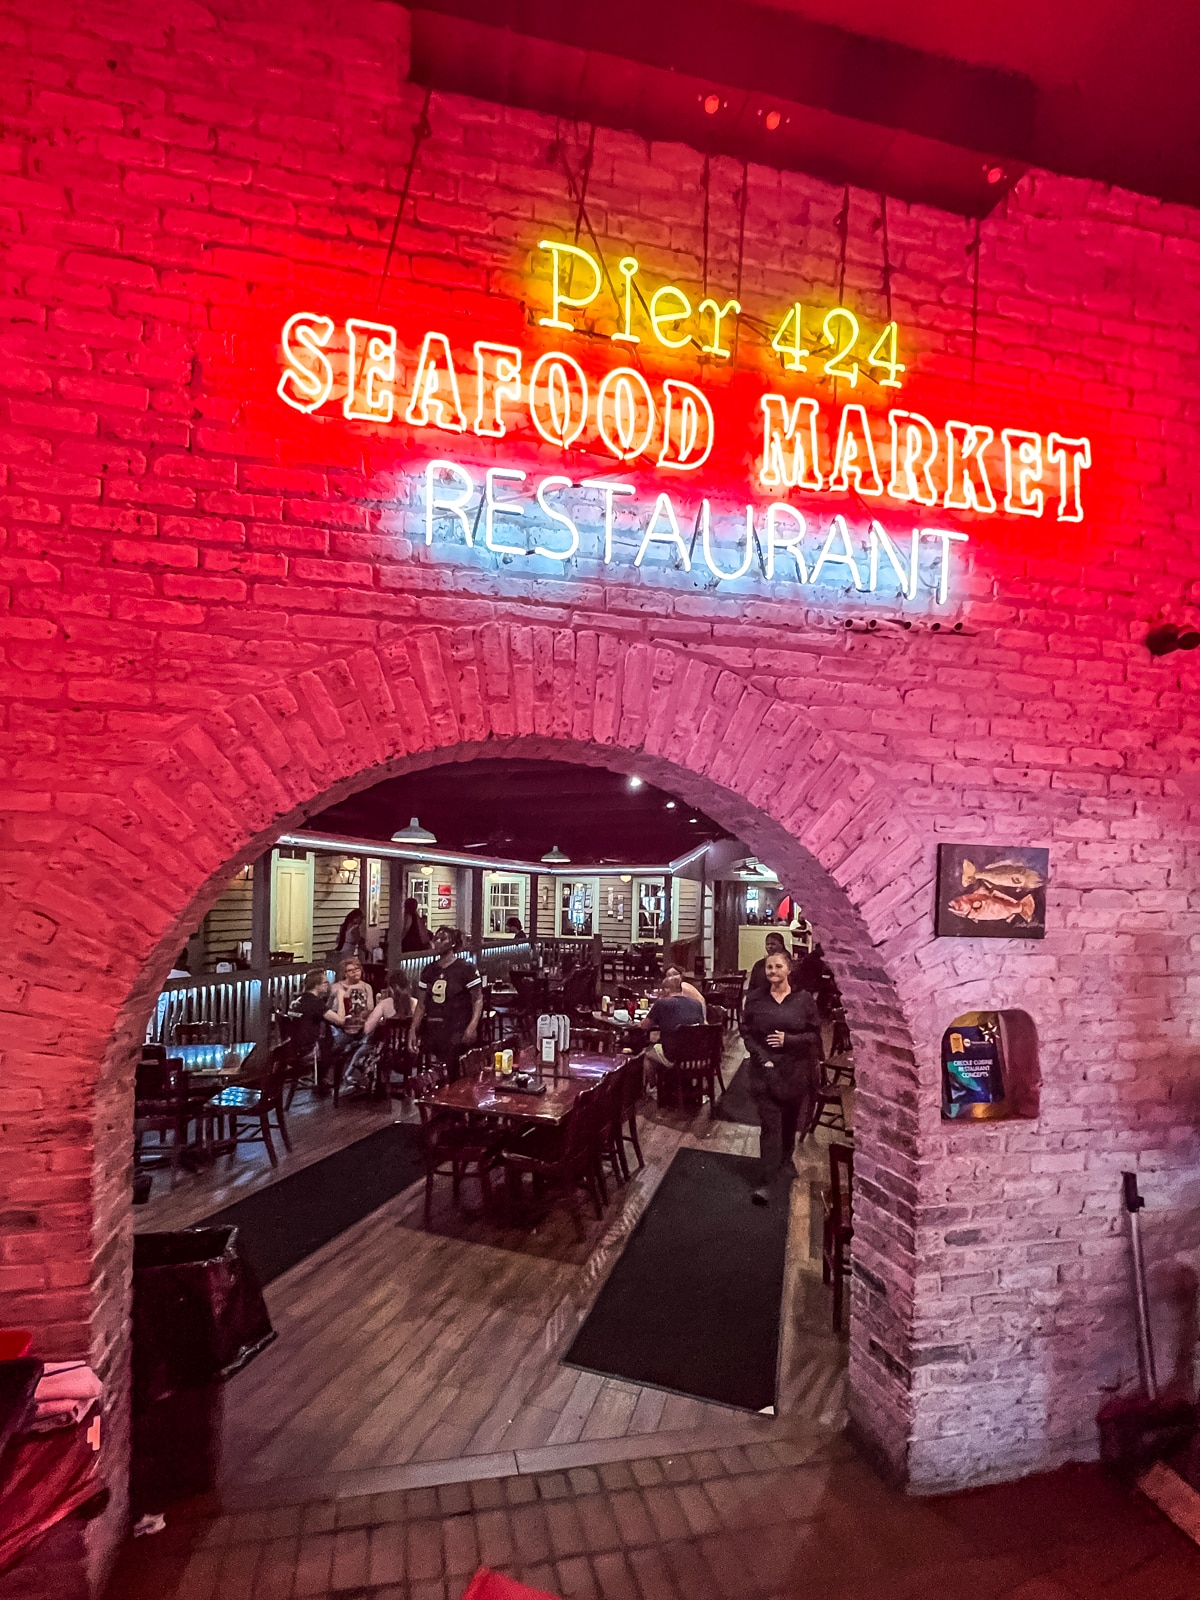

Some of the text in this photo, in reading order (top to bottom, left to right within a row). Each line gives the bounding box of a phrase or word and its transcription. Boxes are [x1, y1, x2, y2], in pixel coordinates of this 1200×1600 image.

[537, 240, 905, 388] Pier 424
[277, 312, 1091, 522] SEAFOOD MARKET
[425, 460, 969, 604] RESTAURANT
[432, 980, 447, 1003] 9
